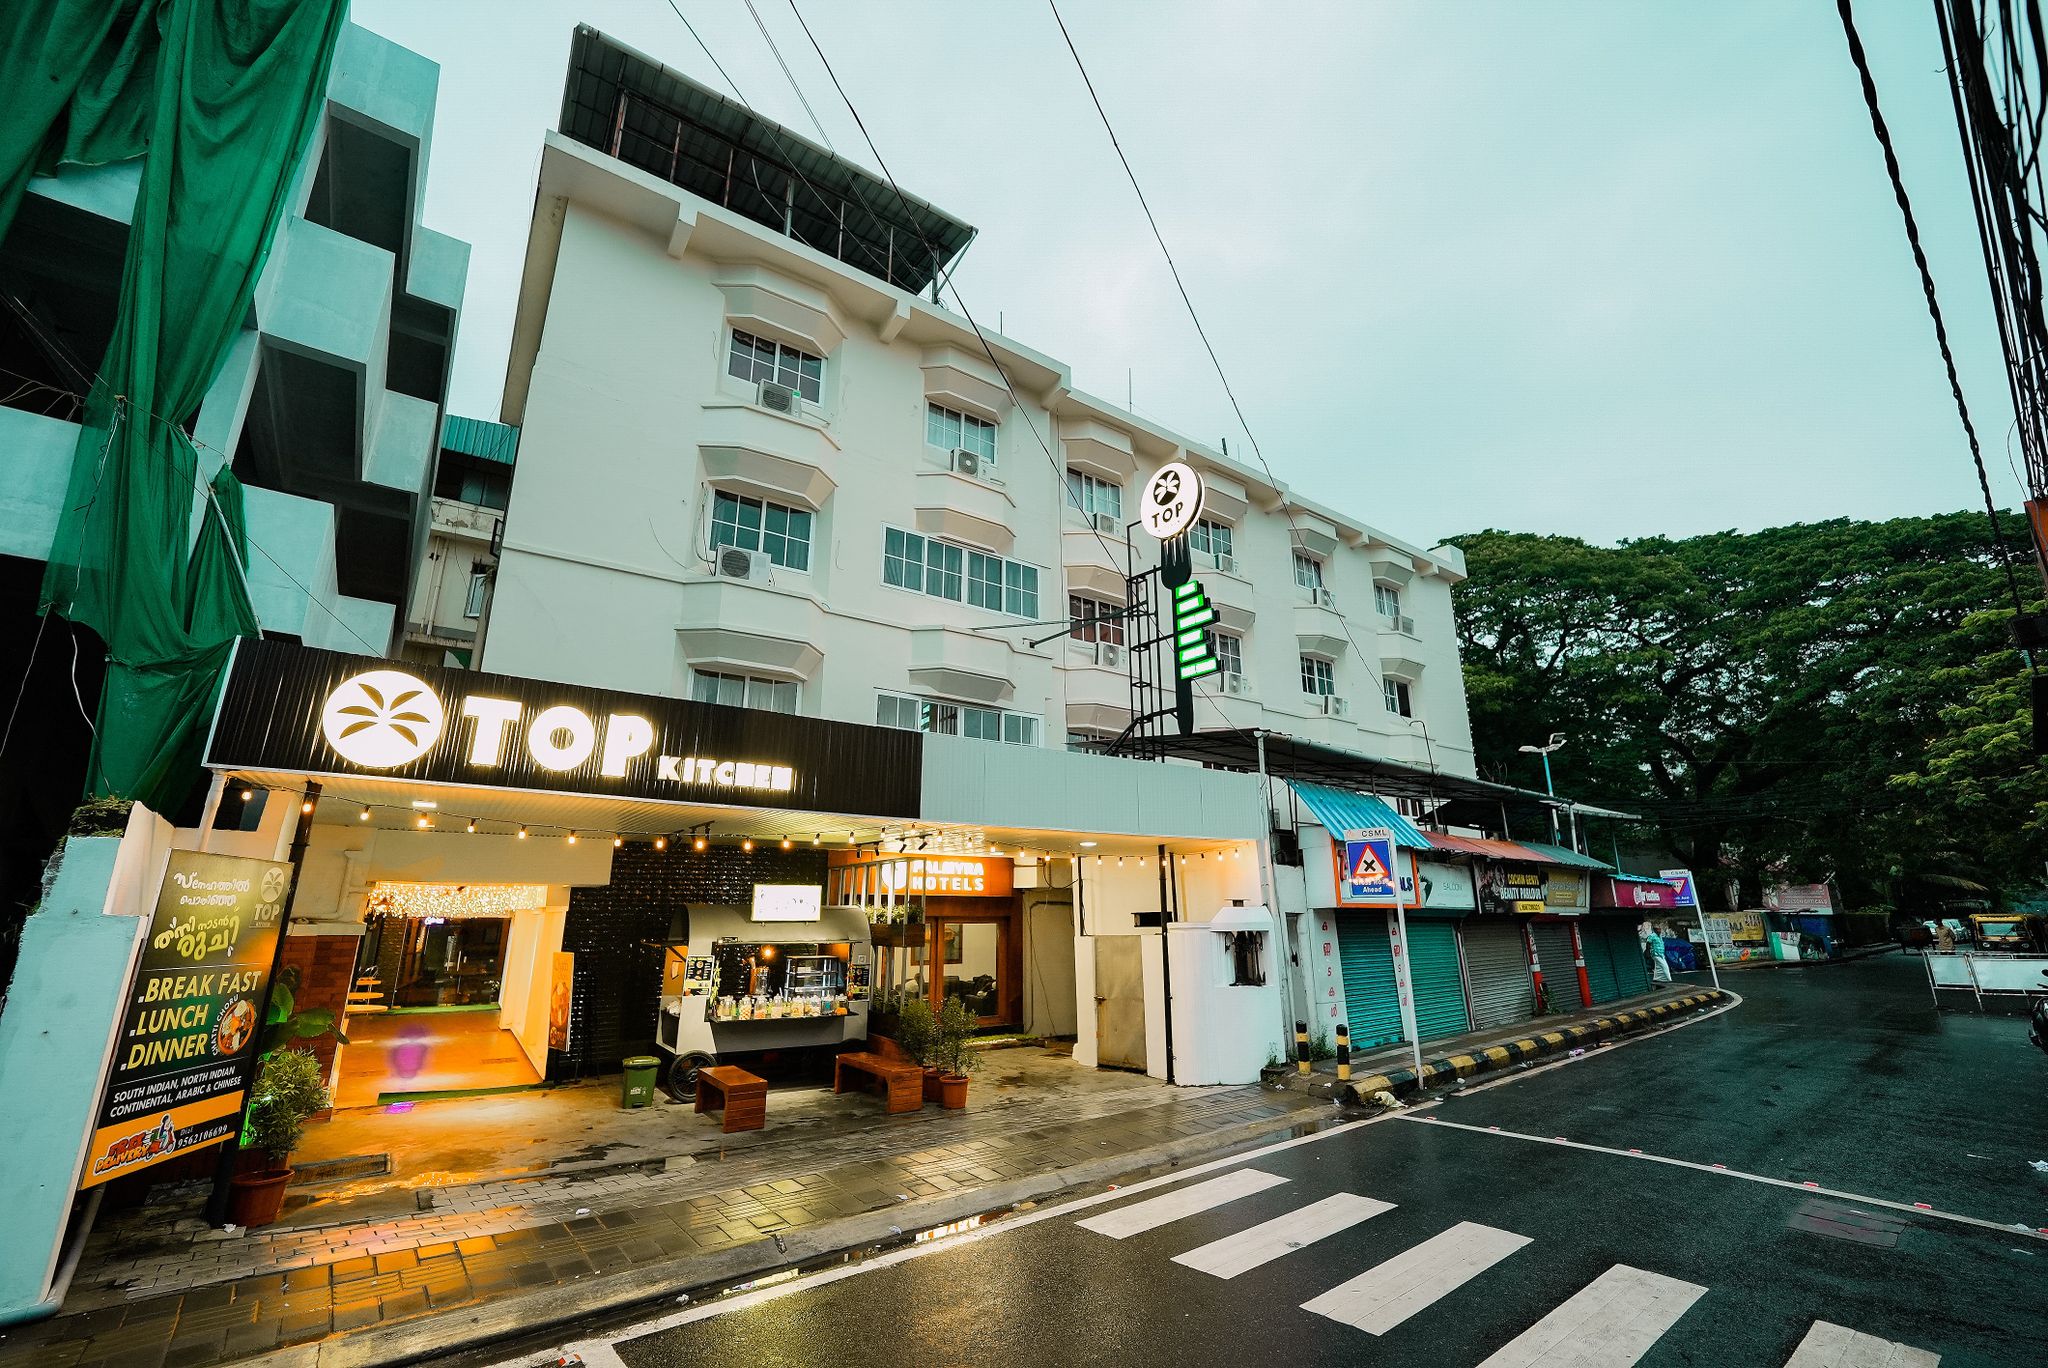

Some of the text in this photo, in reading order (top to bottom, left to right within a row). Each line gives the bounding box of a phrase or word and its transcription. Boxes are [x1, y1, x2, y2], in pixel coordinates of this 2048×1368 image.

[1151, 502, 1184, 528] TOP
[463, 695, 654, 778] TOP
[657, 755, 793, 791] KITCHEN
[1361, 830, 1387, 838] CSML
[912, 859, 984, 876] PALMYRA
[913, 876, 984, 891] HOTELS
[1500, 887, 1520, 900] BEAUTY
[254, 903, 280, 921] TOP
[217, 971, 262, 995] FAST
[216, 993, 240, 1022] CHORU
[110, 1076, 242, 1118] CONTINENTAL, ARABIC & CHINESE
[113, 1065, 236, 1104] SOUTH INDIAN, NORTH INDIAN
[94, 1143, 152, 1176] DELIVERY
